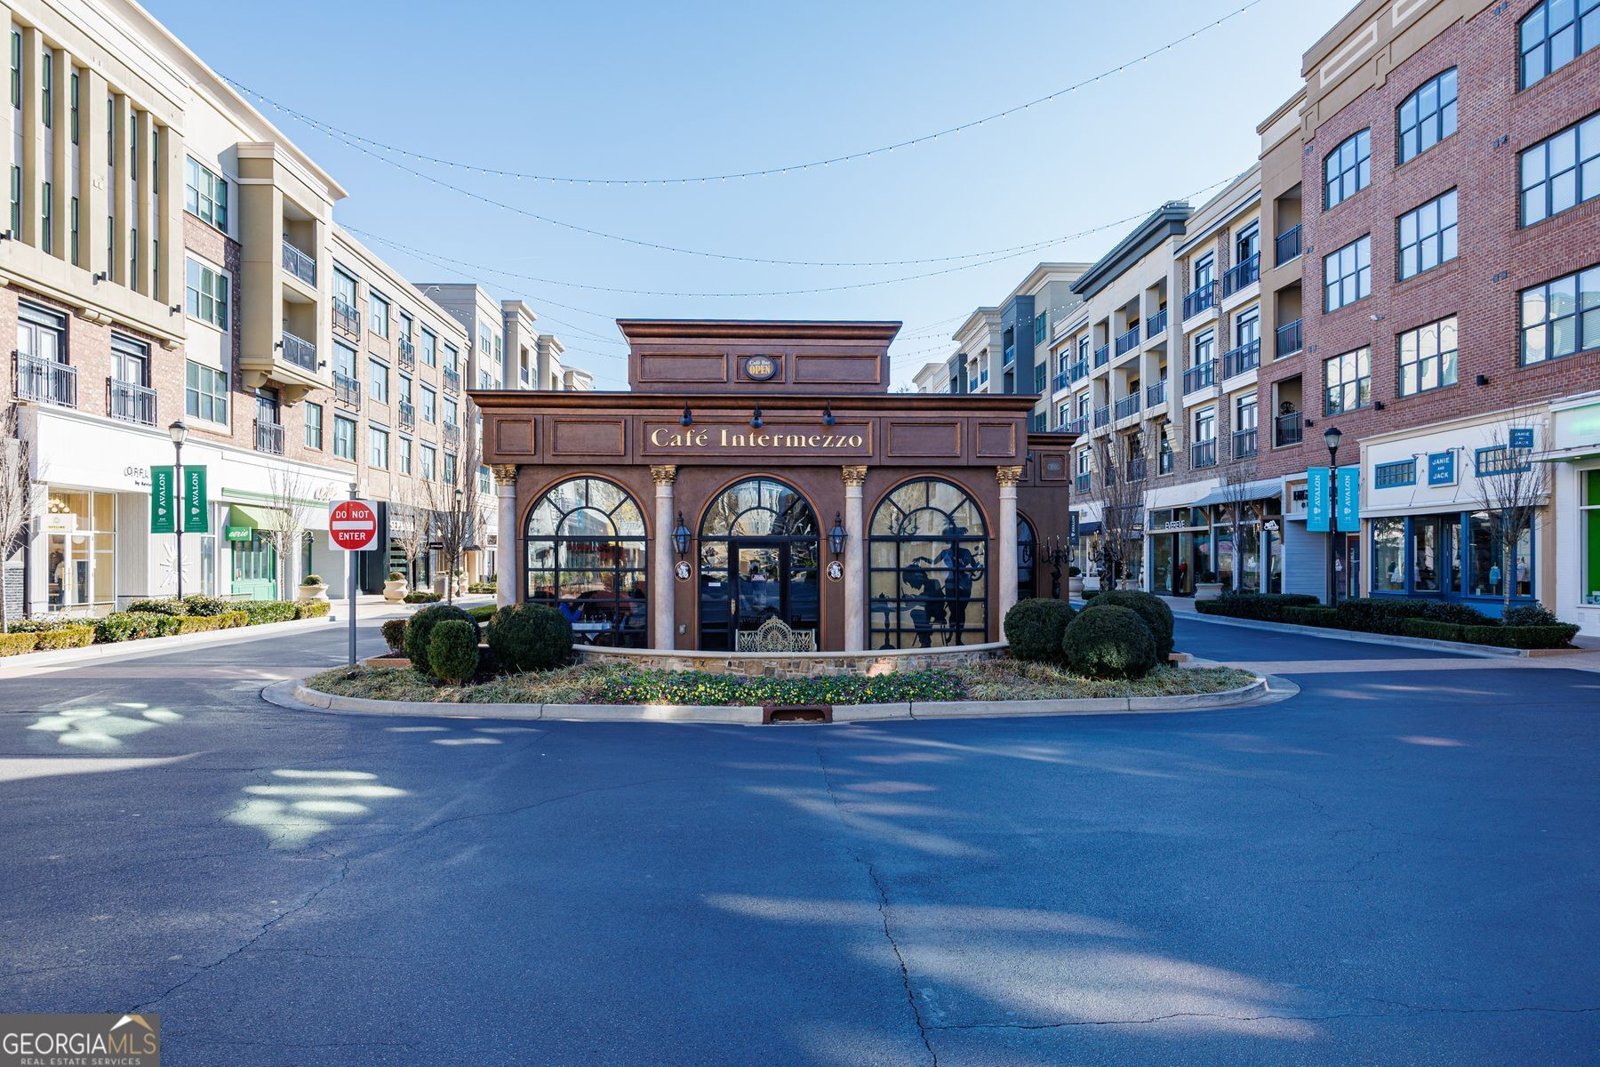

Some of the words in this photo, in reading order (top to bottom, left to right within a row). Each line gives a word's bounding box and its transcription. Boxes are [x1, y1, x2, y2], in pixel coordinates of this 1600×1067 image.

[749, 365, 771, 375] OPEN
[651, 428, 708, 447] Café
[720, 428, 863, 447] Intermezzo
[1432, 457, 1450, 465] JANIE
[336, 511, 347, 519] DO
[352, 510, 370, 518] NOT
[228, 529, 249, 537] aerie
[338, 532, 366, 540] ENTER
